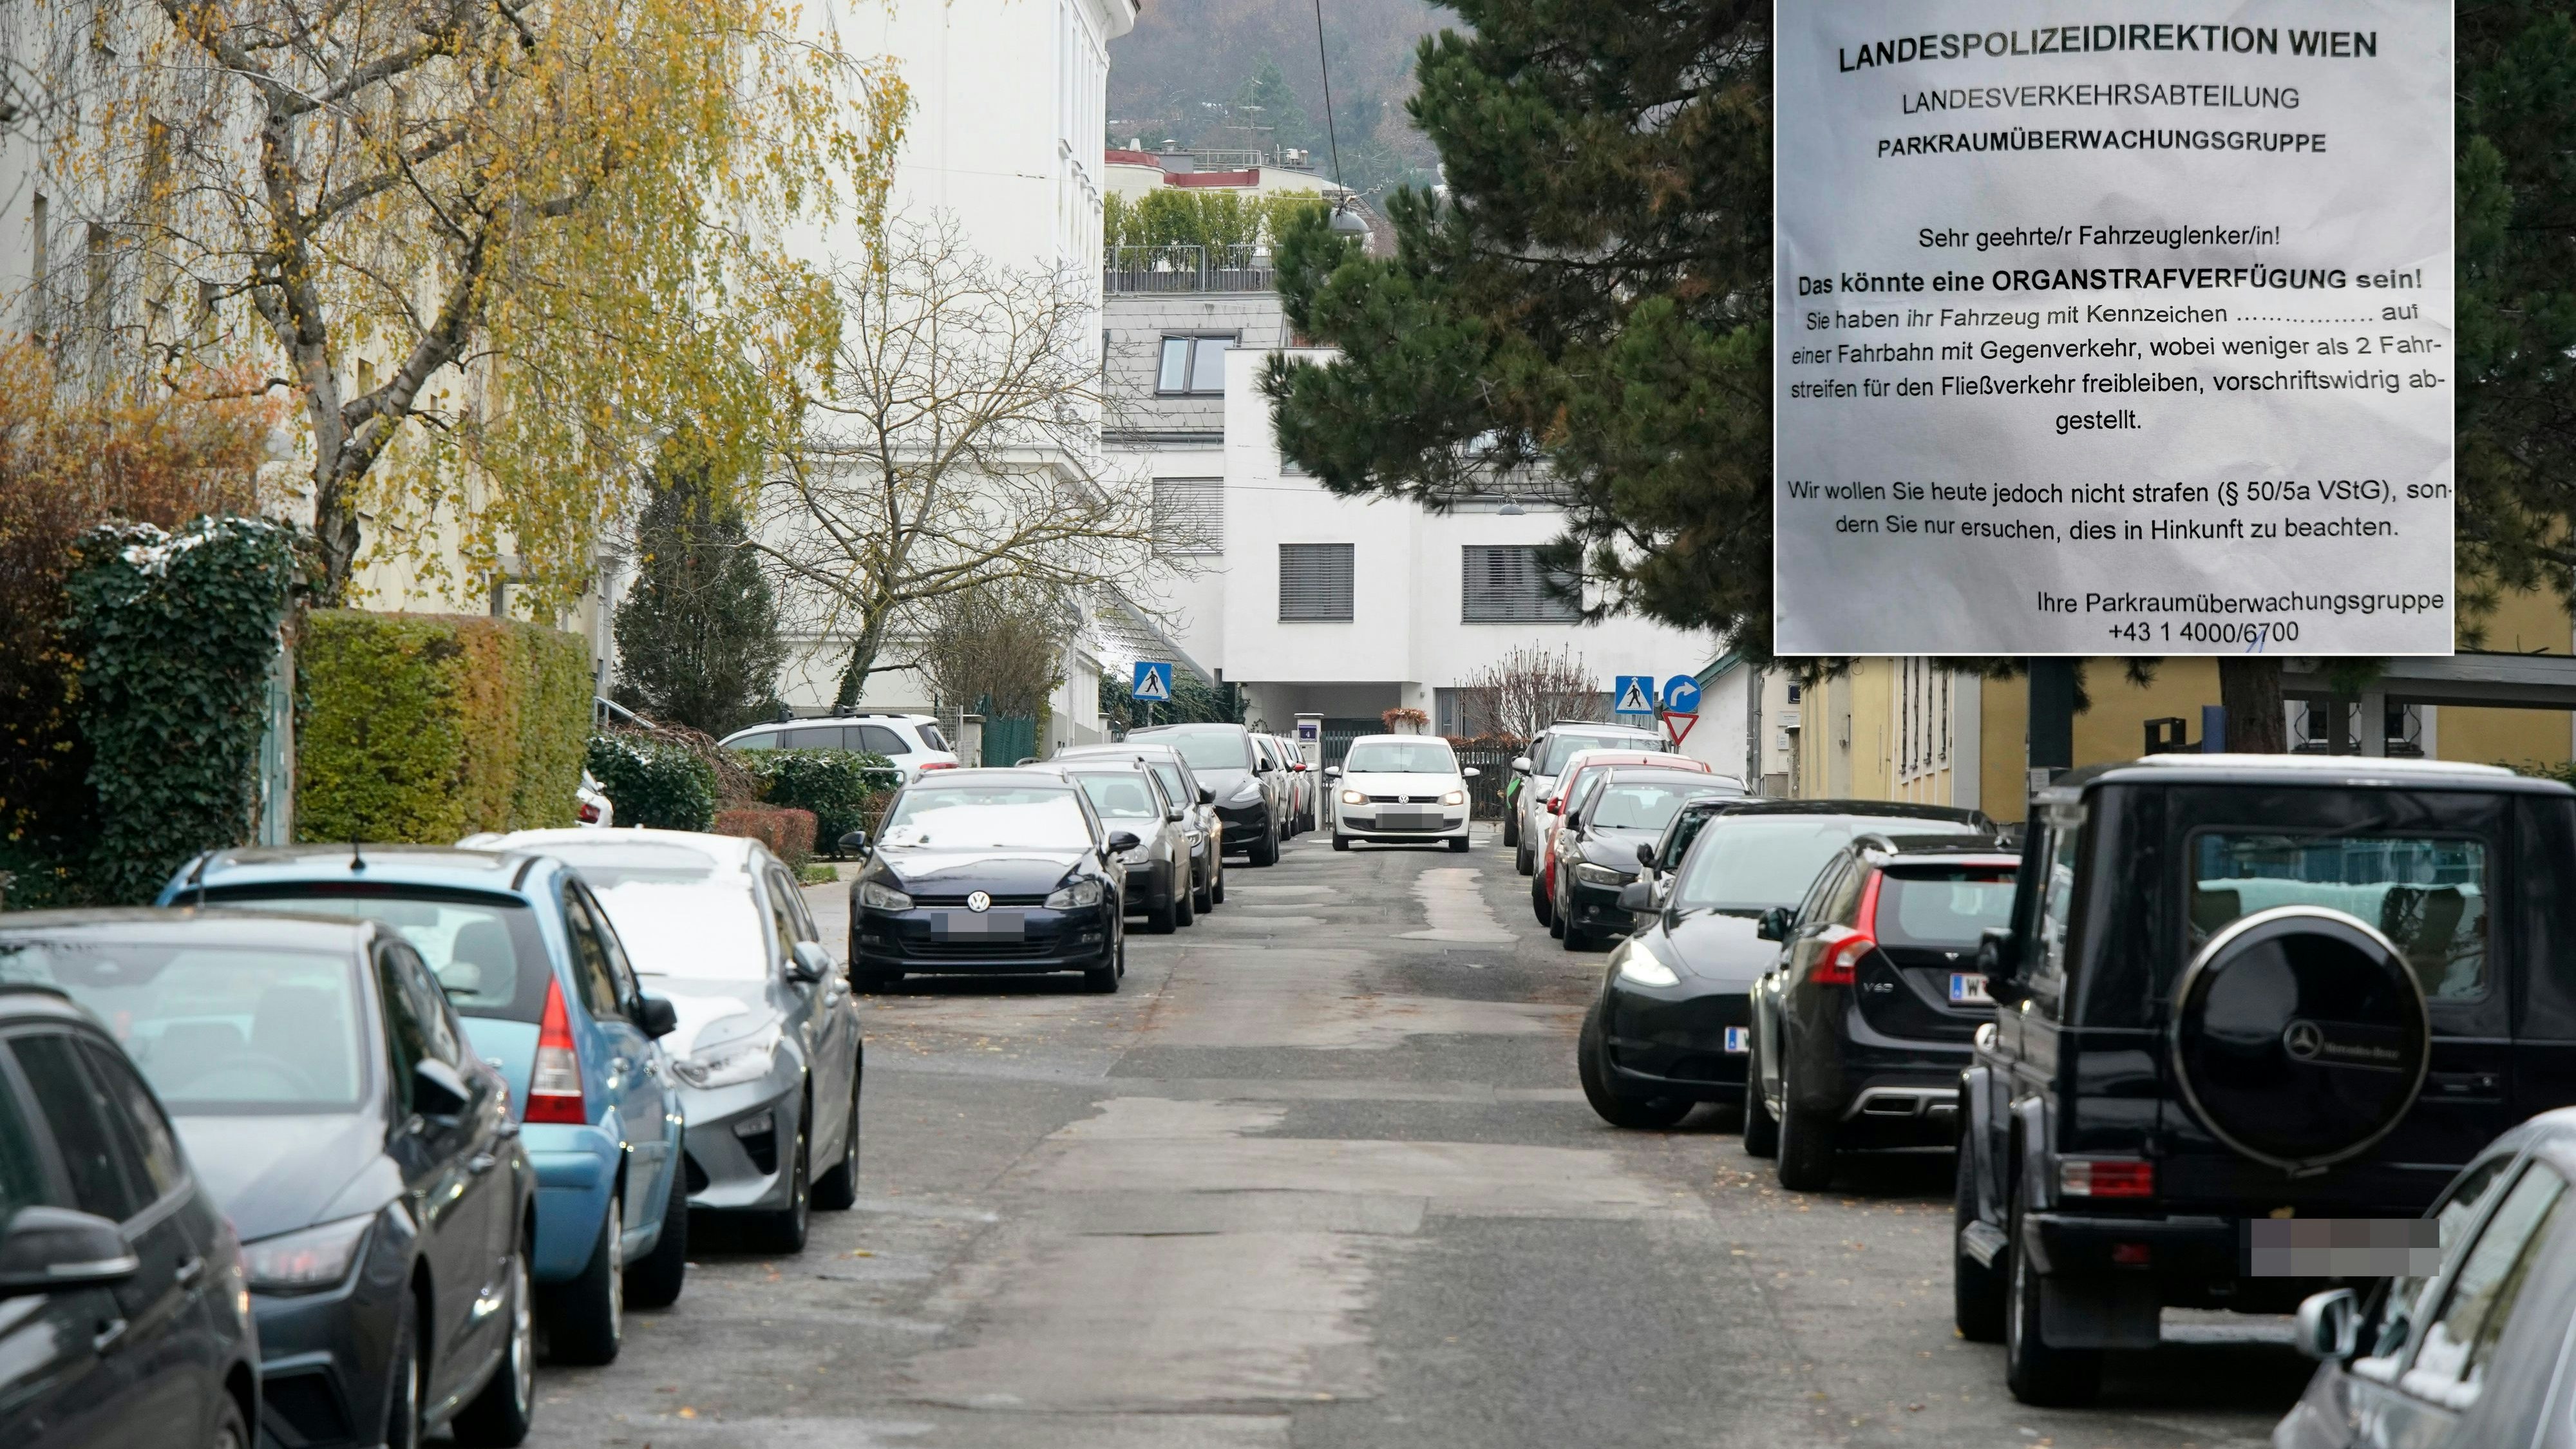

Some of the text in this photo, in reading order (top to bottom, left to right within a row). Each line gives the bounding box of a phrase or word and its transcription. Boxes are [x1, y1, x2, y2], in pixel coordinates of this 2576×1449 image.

[1839, 23, 2377, 73] LANDESPOLIZEIDIREKTION WIEN
[1903, 83, 2299, 115] LANDESVERKEHRSABTEILUNG
[1878, 126, 2327, 158] PARKRAUMÜBERWACHUNGSGRUPPE
[1918, 224, 2280, 252] Sehr geehrte/r Fahrzeuglenker/in!
[1799, 263, 2422, 296] Das könnte eine ORGANSTRAFVERFÜGUNG sein!
[1806, 311, 1830, 331] Sie
[1835, 310, 1899, 329] haben
[1907, 308, 1935, 327] ihr
[1940, 308, 2040, 330] Fahrzeug
[2047, 305, 2079, 325] mit
[2087, 304, 2228, 323] Kennzeichen
[2381, 303, 2418, 321] auf
[1792, 335, 2442, 365] einer Fahrbahn mit Gegenverkehr, wobei weniger als 2 Fahr-
[1791, 368, 2446, 399] streifen für den Fließverkehr freibleiben, vorschriftswidrig ab-
[2056, 409, 2141, 435] gestellt.
[1787, 480, 1821, 499] Wir
[1824, 481, 1886, 500] wollen
[1893, 481, 1925, 500] Sie
[1931, 481, 1987, 502] heute
[1992, 482, 2063, 507] jedoch
[2071, 482, 2125, 504] nicht
[2132, 482, 2209, 503] strafen
[2217, 481, 2239, 507] (§
[2246, 480, 2311, 501] 50/5a
[2317, 479, 2396, 504] VStG),
[1835, 515, 2398, 544] dern Sie nur ersuchen, dies in Hinkunft zu beachten.
[2038, 590, 2445, 615] Ihre Parkraumüberwachungsgruppe
[2108, 620, 2299, 643] +43 1 4000/6700
[969, 892, 989, 911] VW
